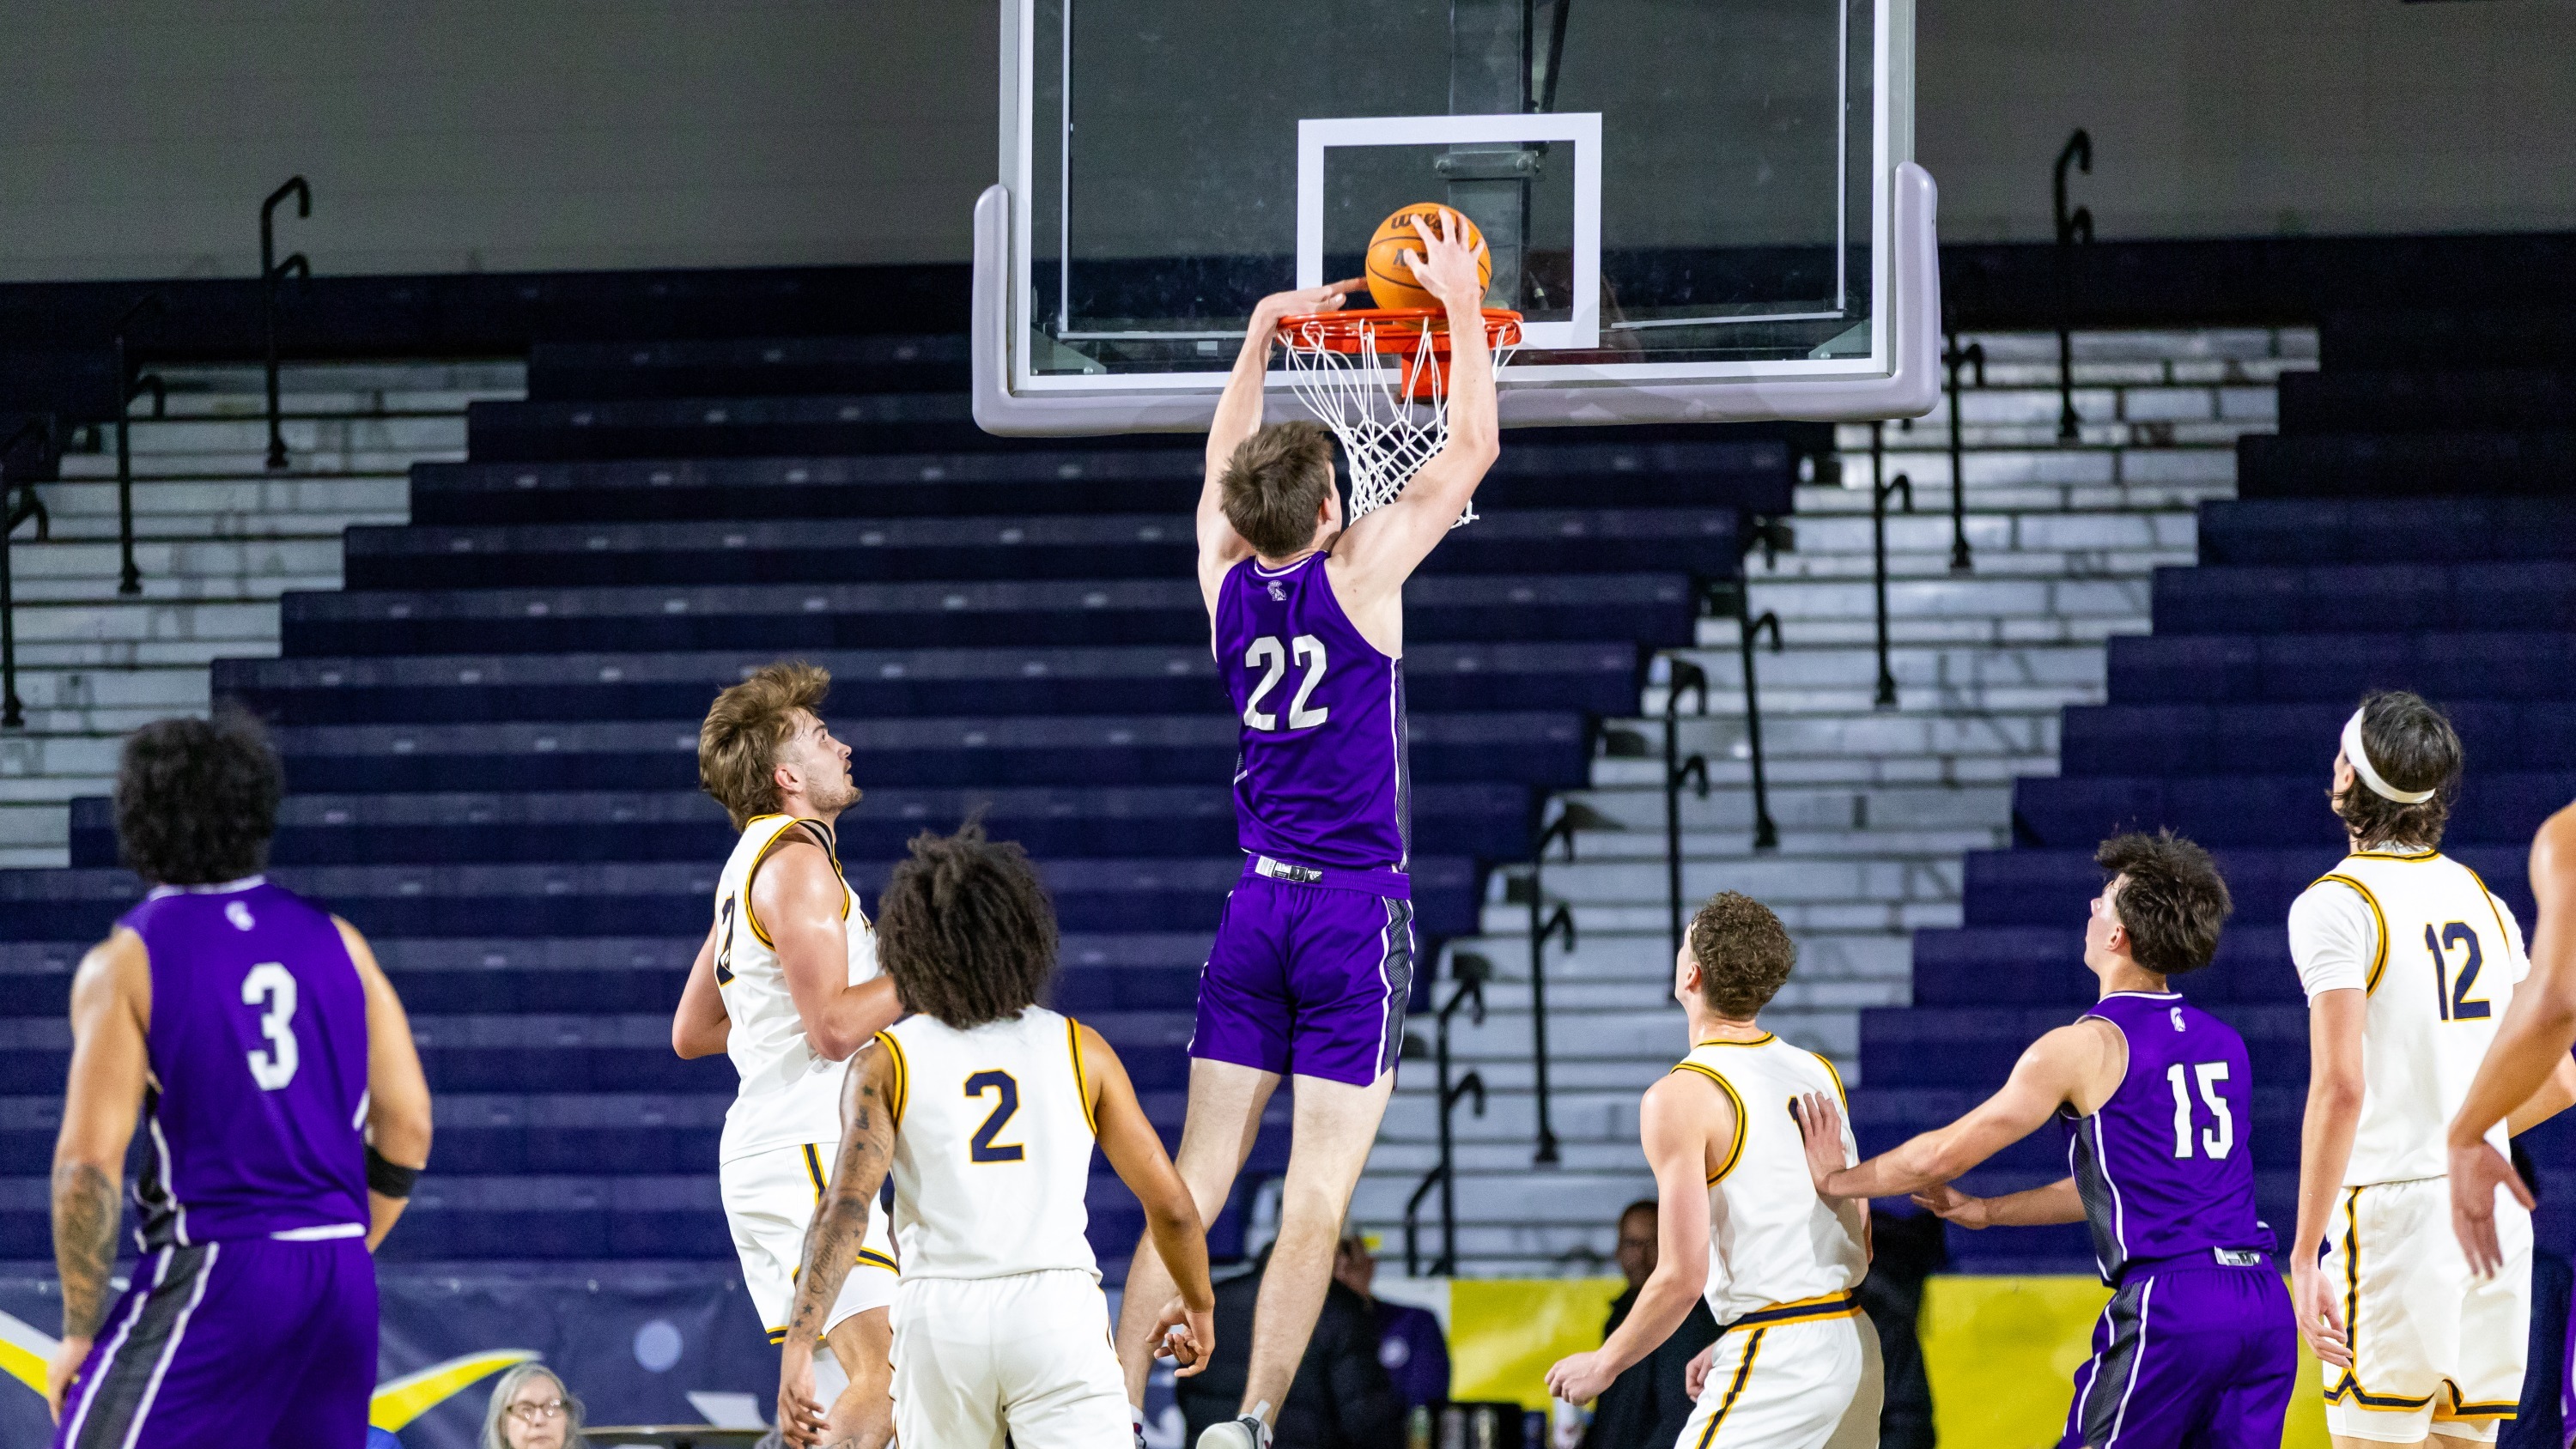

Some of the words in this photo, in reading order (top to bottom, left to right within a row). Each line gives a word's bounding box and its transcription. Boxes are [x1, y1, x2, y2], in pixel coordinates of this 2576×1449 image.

[1243, 634, 1328, 731] 22
[2424, 920, 2491, 1022] 12
[240, 961, 300, 1092] 3
[963, 1068, 1025, 1165] 2
[2166, 1061, 2233, 1160] 15
